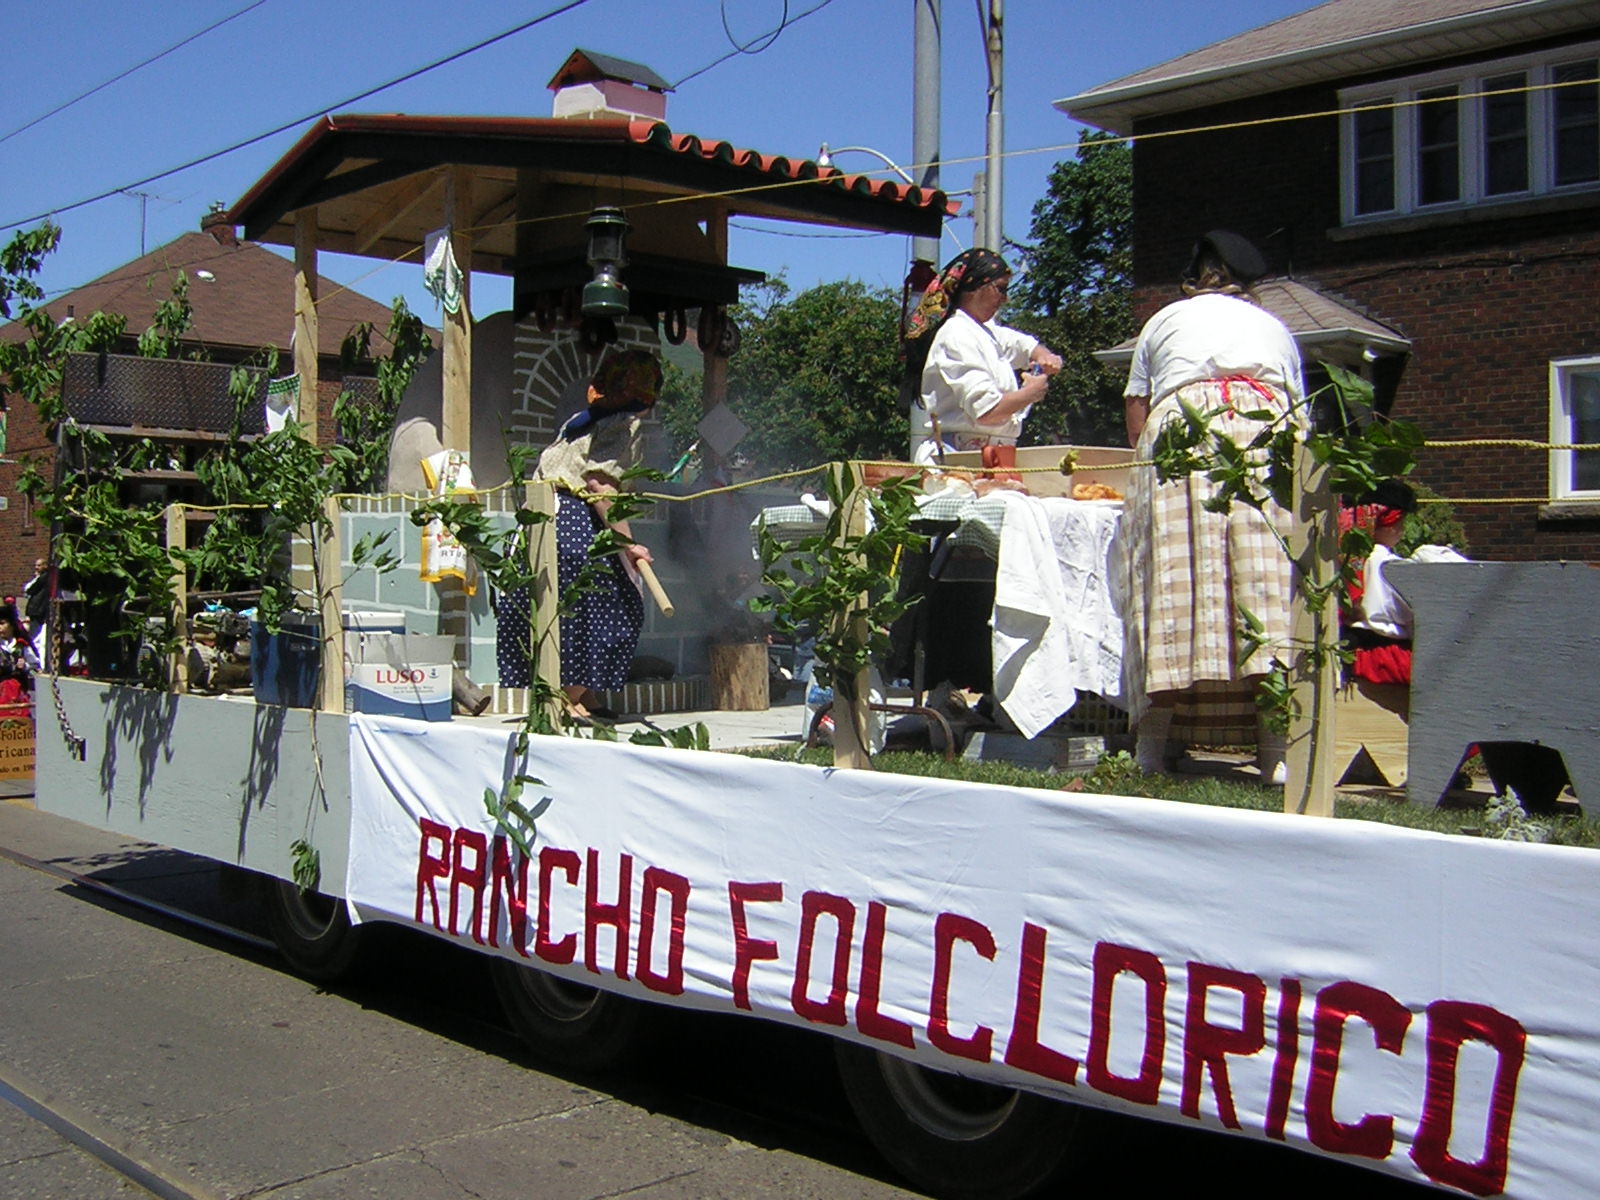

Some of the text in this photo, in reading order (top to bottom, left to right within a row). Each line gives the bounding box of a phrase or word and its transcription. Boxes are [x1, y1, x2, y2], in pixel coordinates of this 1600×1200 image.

[376, 668, 425, 684] LUSO
[415, 817, 1526, 1196] RANCHO FOLCLORICO
